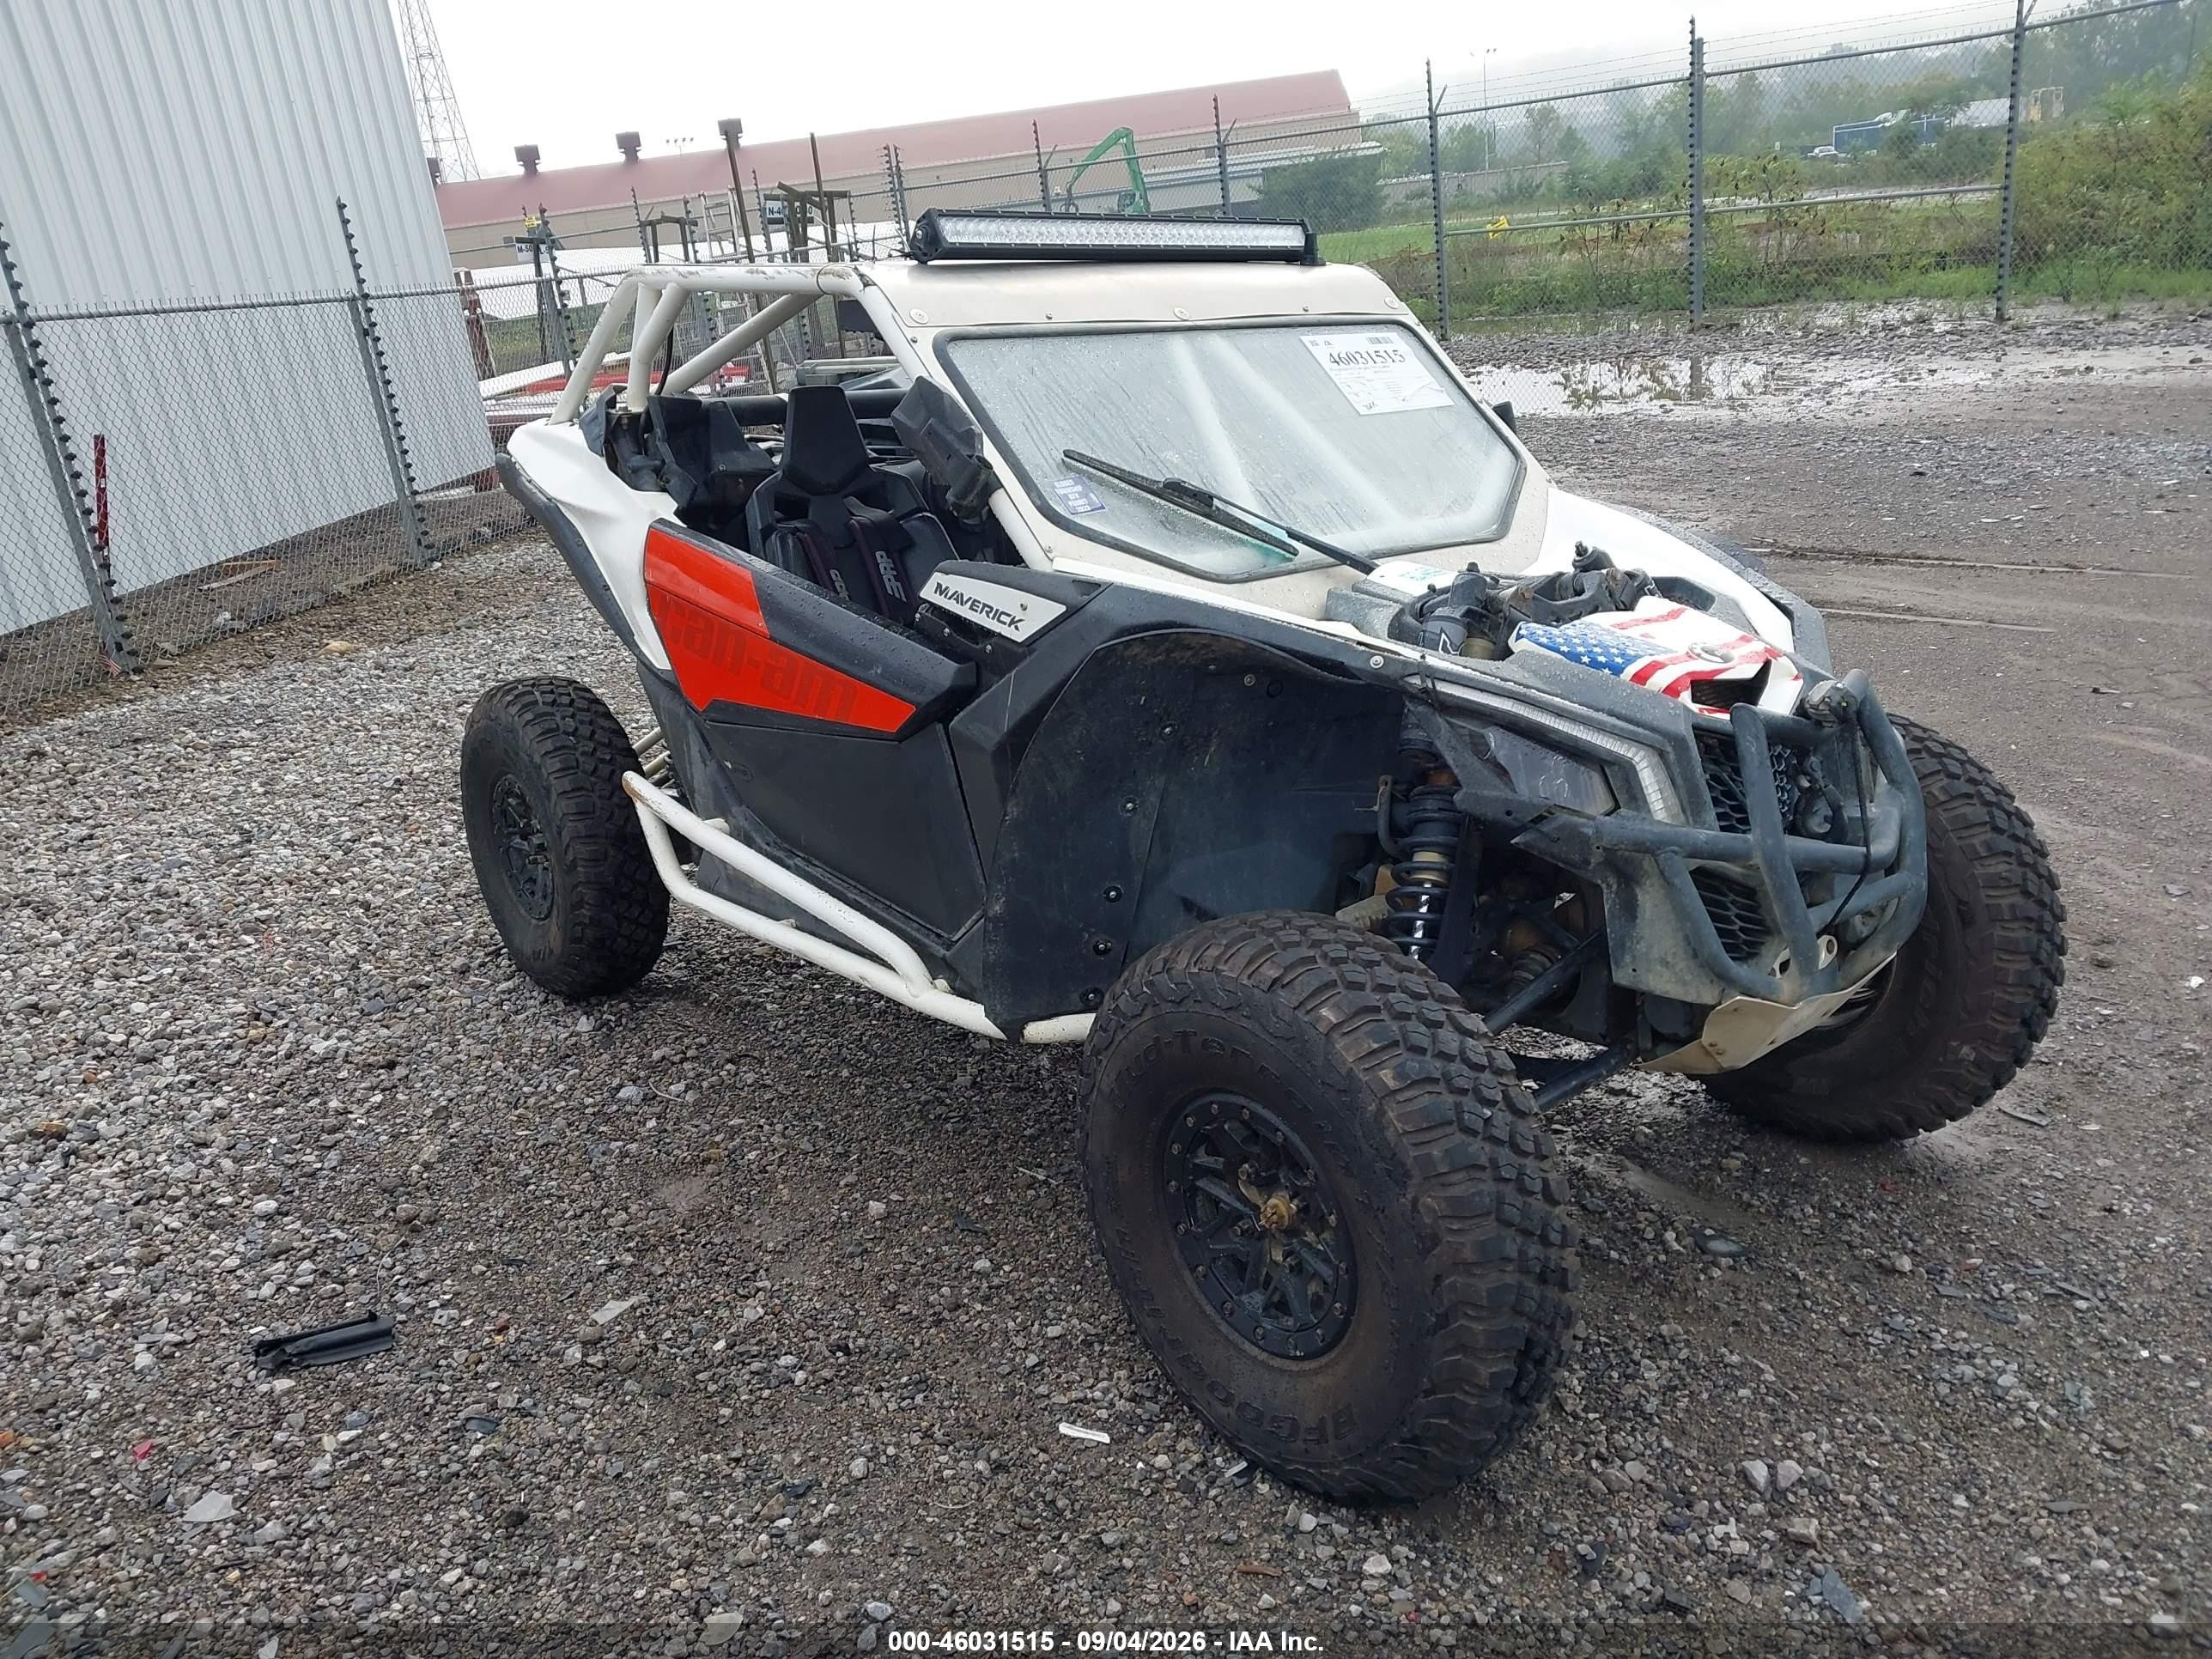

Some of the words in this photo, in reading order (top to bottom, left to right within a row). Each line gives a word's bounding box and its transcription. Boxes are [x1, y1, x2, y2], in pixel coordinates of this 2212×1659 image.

[1329, 349, 1406, 367] 46031515
[830, 568, 851, 602] RP
[933, 581, 1025, 632] MAVERICK
